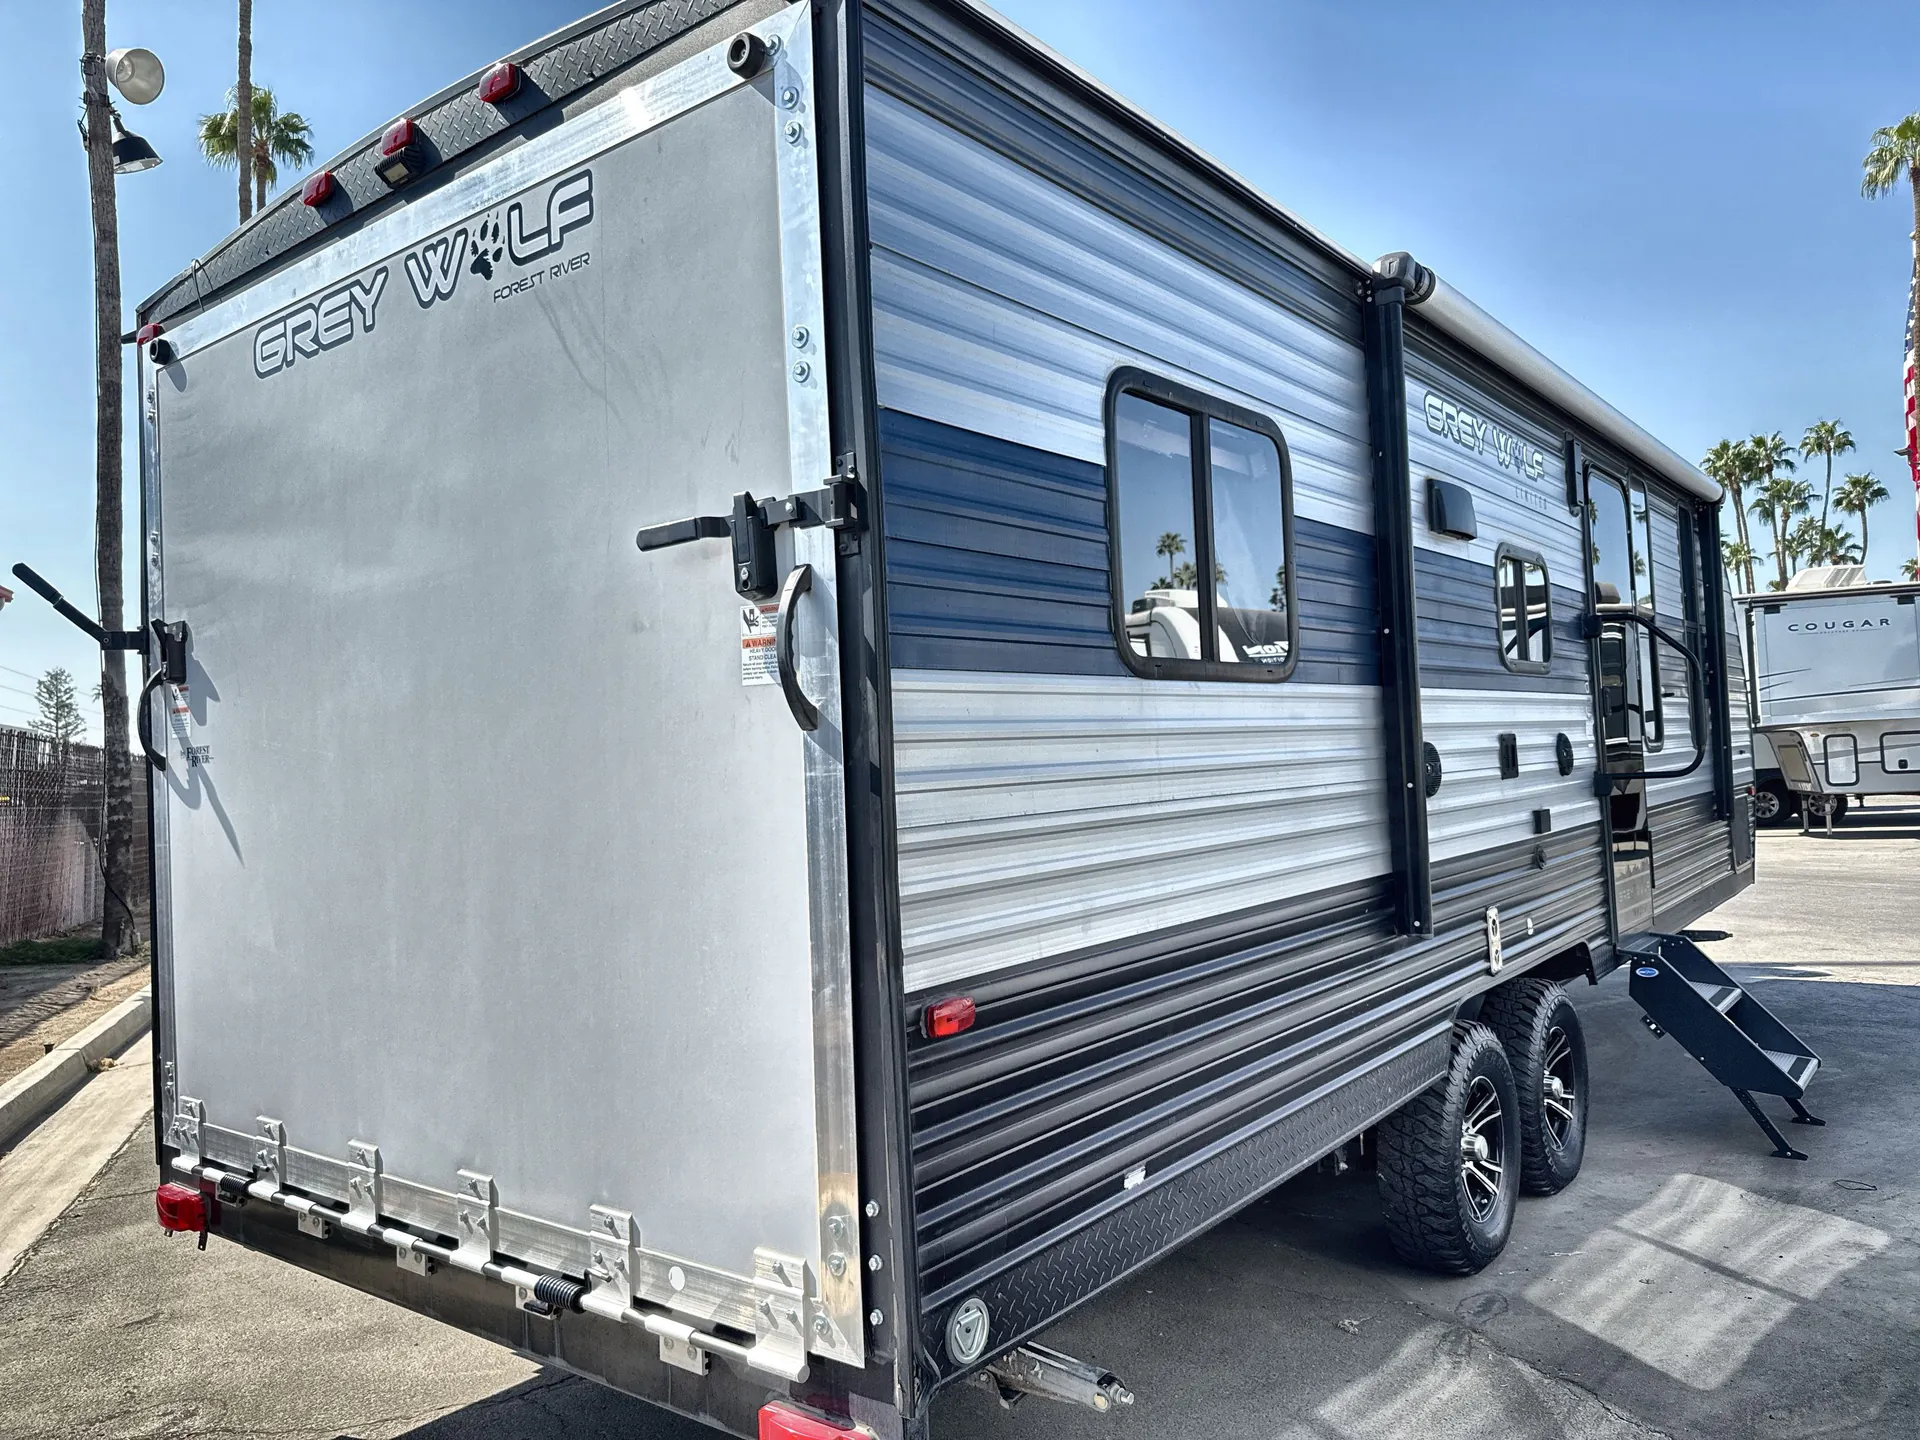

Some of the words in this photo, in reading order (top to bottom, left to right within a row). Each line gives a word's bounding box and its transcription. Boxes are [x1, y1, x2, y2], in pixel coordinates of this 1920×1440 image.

[254, 266, 389, 379] GREY
[404, 168, 594, 309] WLF
[494, 270, 545, 303] FOREST
[549, 252, 590, 279] RIVER
[1424, 390, 1487, 456] GREY
[1492, 426, 1545, 482] WLF
[1788, 618, 1890, 632] COUGAR
[751, 637, 776, 647] WARNI
[186, 745, 210, 758] FOREST
[191, 755, 211, 767] RIVER
